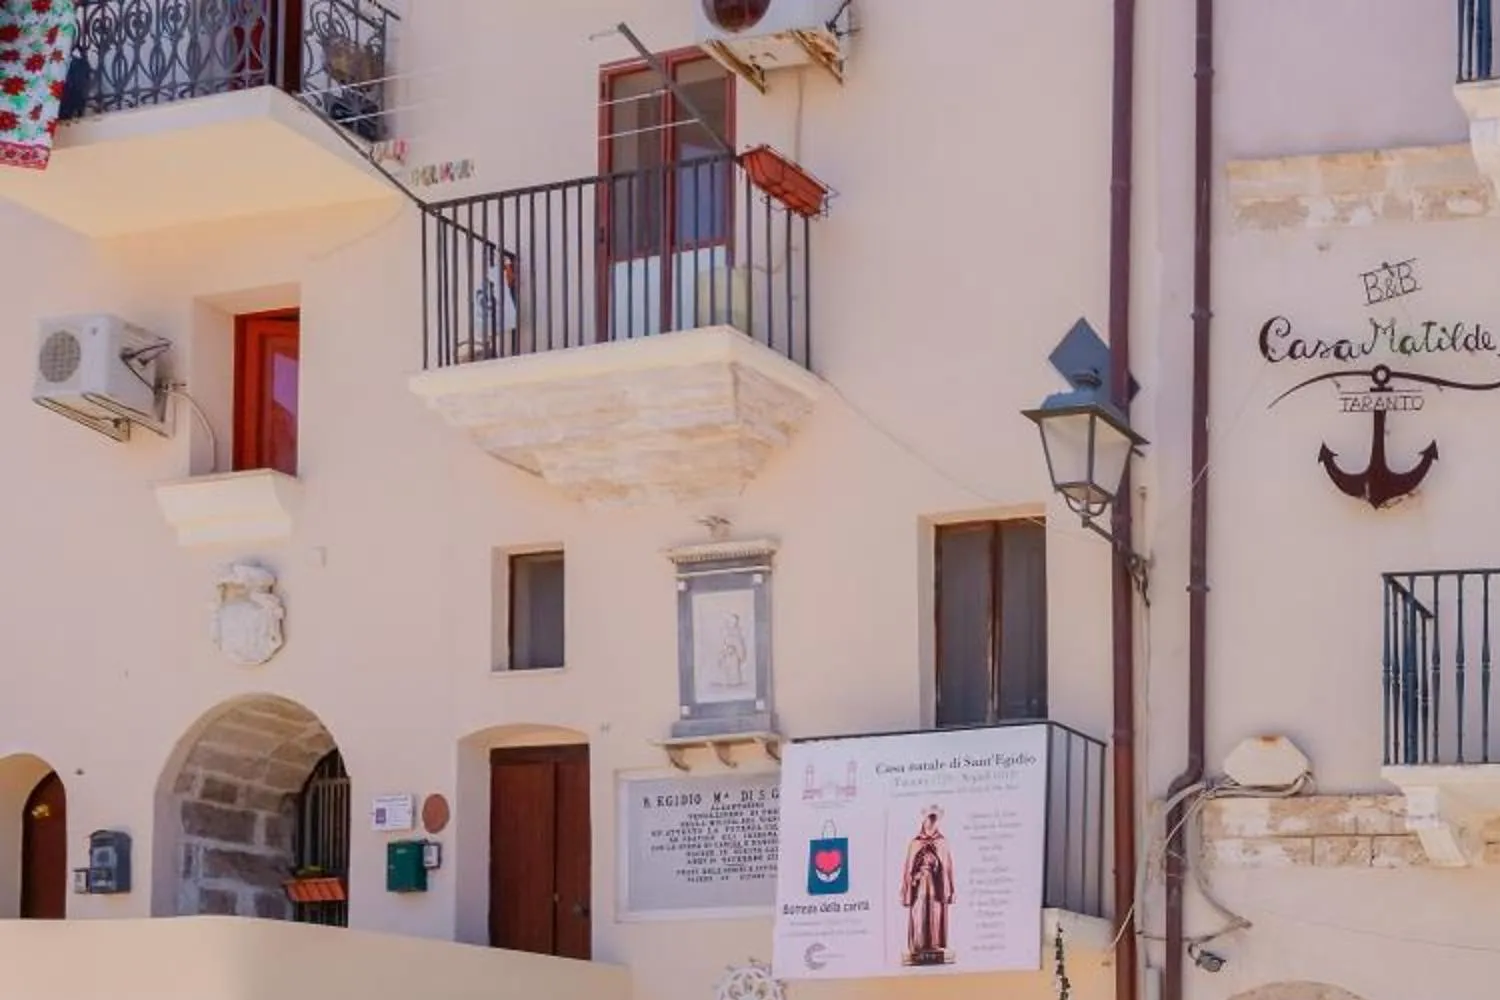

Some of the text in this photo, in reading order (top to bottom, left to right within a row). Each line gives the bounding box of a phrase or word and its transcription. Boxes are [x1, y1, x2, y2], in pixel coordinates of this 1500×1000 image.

[1362, 261, 1421, 304] B&B
[1259, 315, 1498, 364] Casa Matilde
[1340, 395, 1425, 413] TARANTO
[875, 751, 1038, 775] Casa natale di Sant'Egidio
[657, 794, 702, 807] EGIDIO
